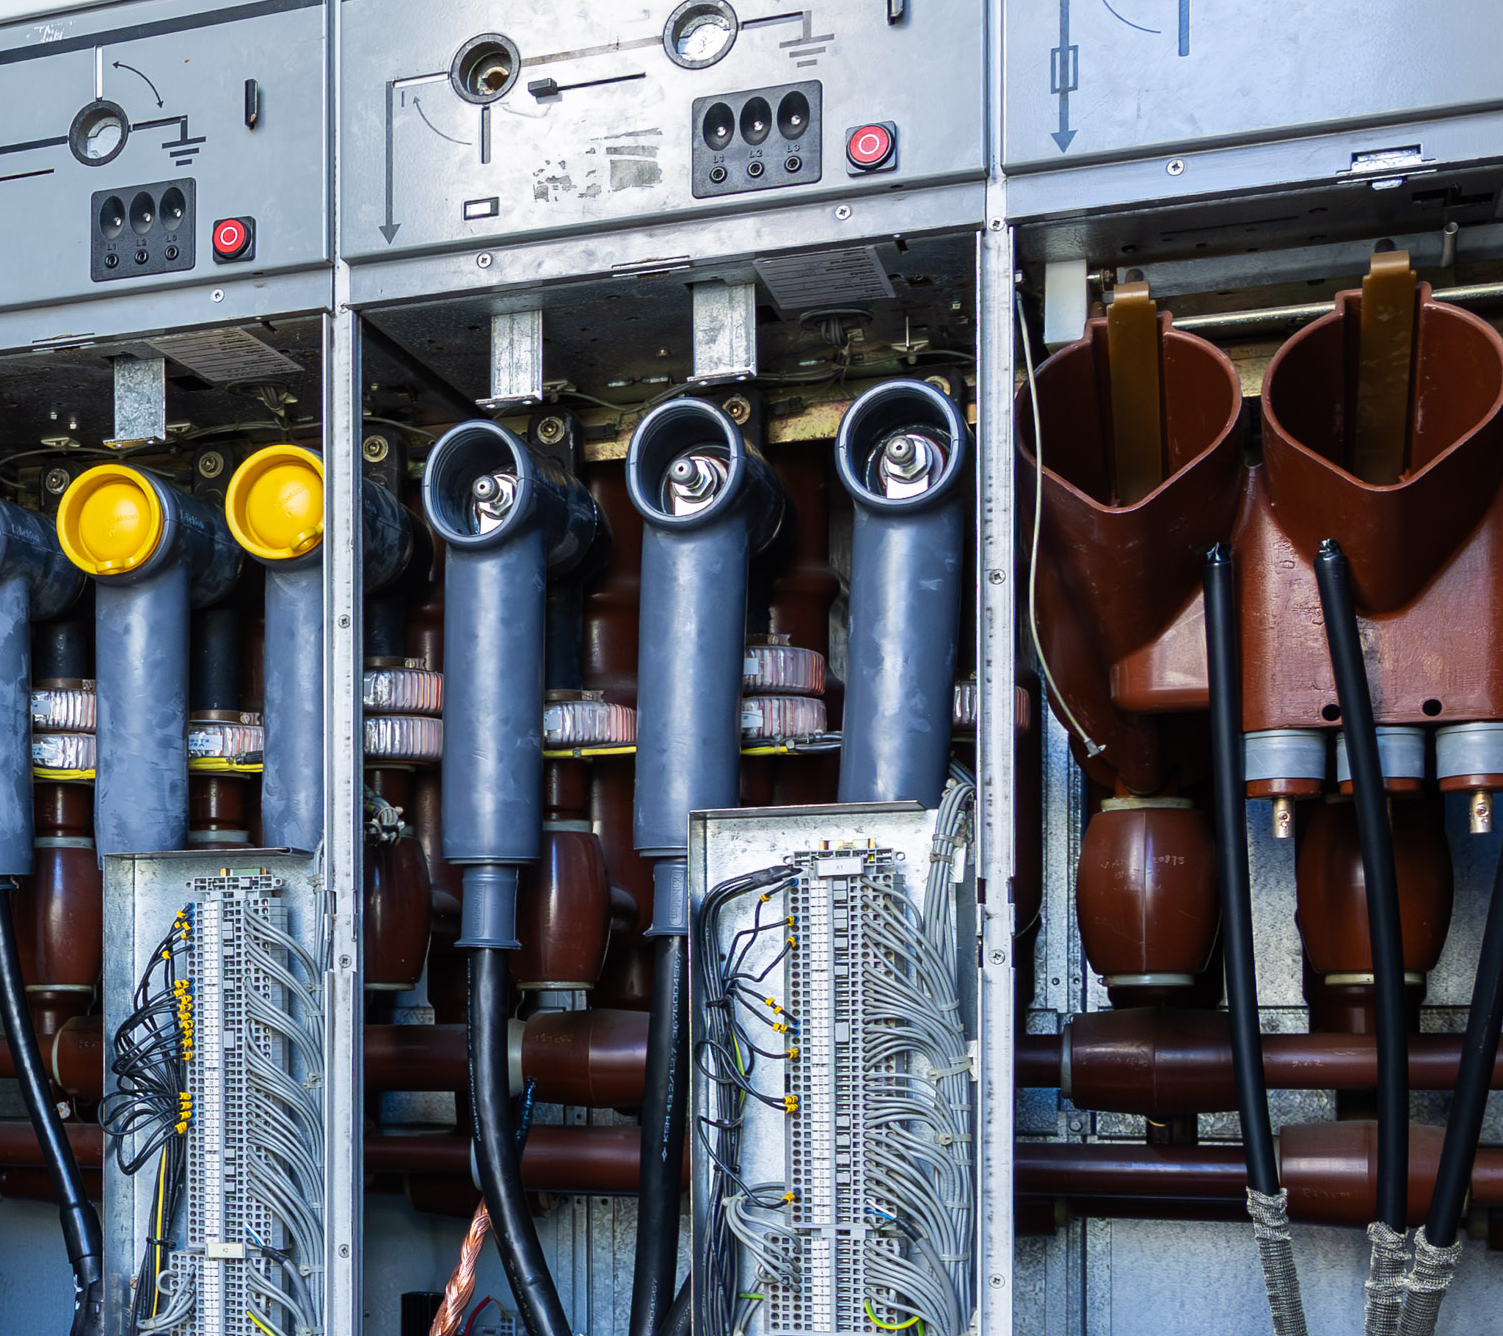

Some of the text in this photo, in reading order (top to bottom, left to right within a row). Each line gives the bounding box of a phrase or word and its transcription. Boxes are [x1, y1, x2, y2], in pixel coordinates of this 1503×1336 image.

[748, 148, 763, 159] L2
[786, 143, 800, 154] L3
[713, 154, 724, 164] L1
[663, 1116, 671, 1143] KSM
